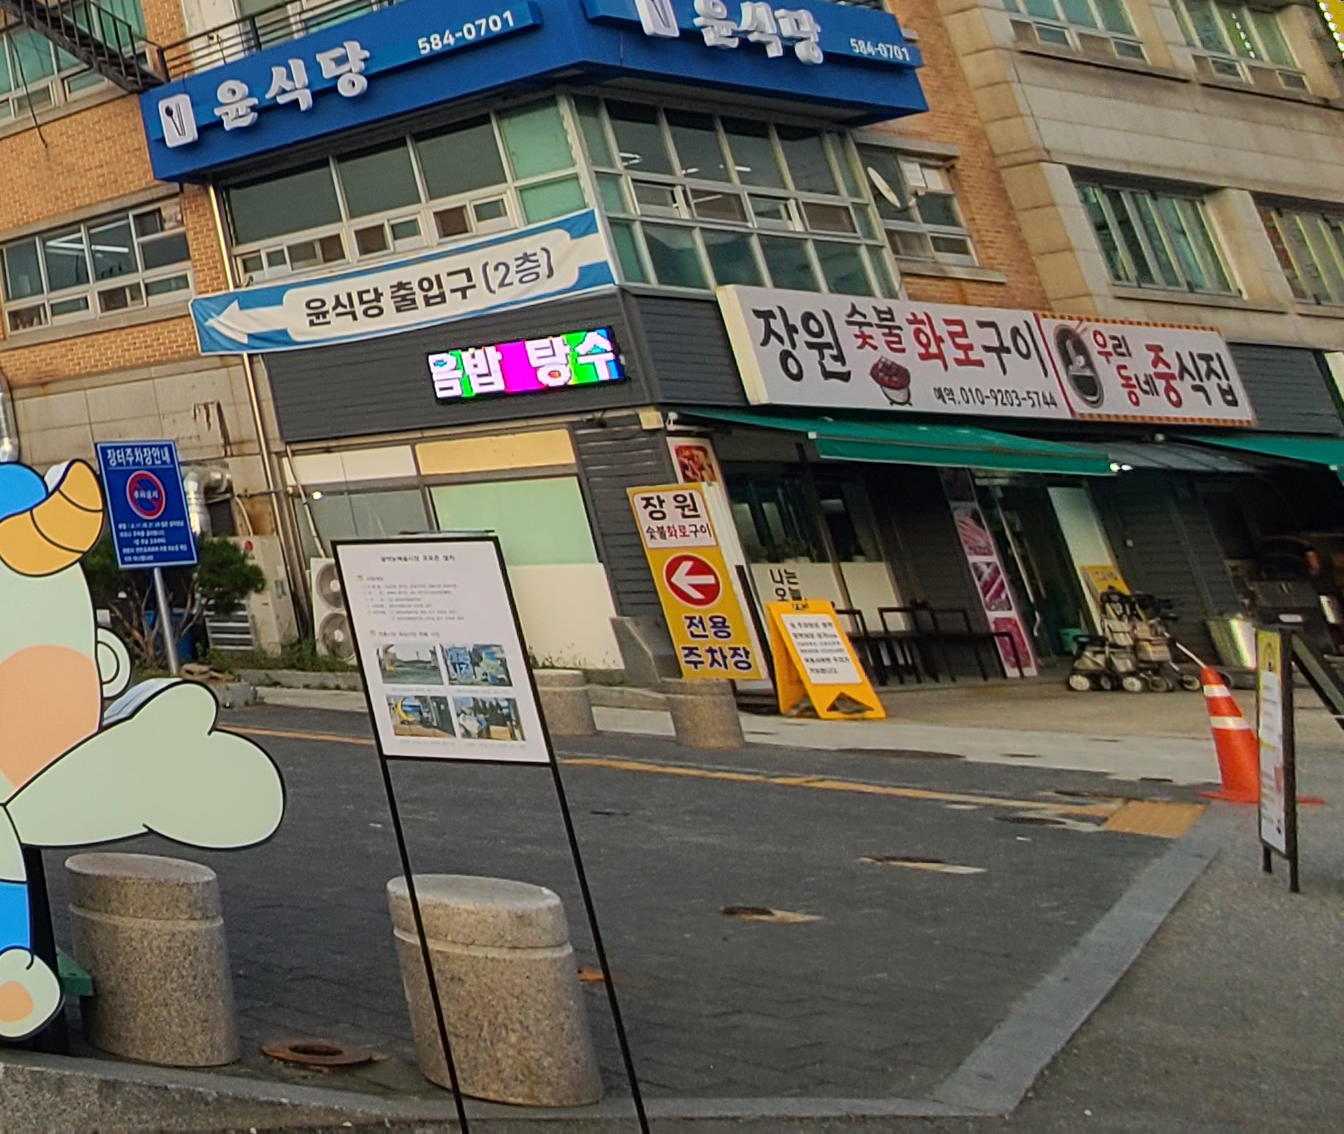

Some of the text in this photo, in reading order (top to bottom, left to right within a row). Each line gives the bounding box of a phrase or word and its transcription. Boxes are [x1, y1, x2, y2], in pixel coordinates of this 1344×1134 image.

[214, 10, 516, 131] 윤식당 584-0701
[849, 37, 911, 62] 584-0701
[304, 246, 556, 327] 윤식당 출입구 (2층)
[525, 330, 616, 387] 탕수
[752, 305, 852, 384] 장원
[1092, 330, 1240, 409] 우리 동네 중식집
[641, 492, 701, 522] 장원
[645, 522, 713, 541] 숯불화로구이
[683, 615, 732, 639] 전용
[681, 645, 753, 671] 주차장
